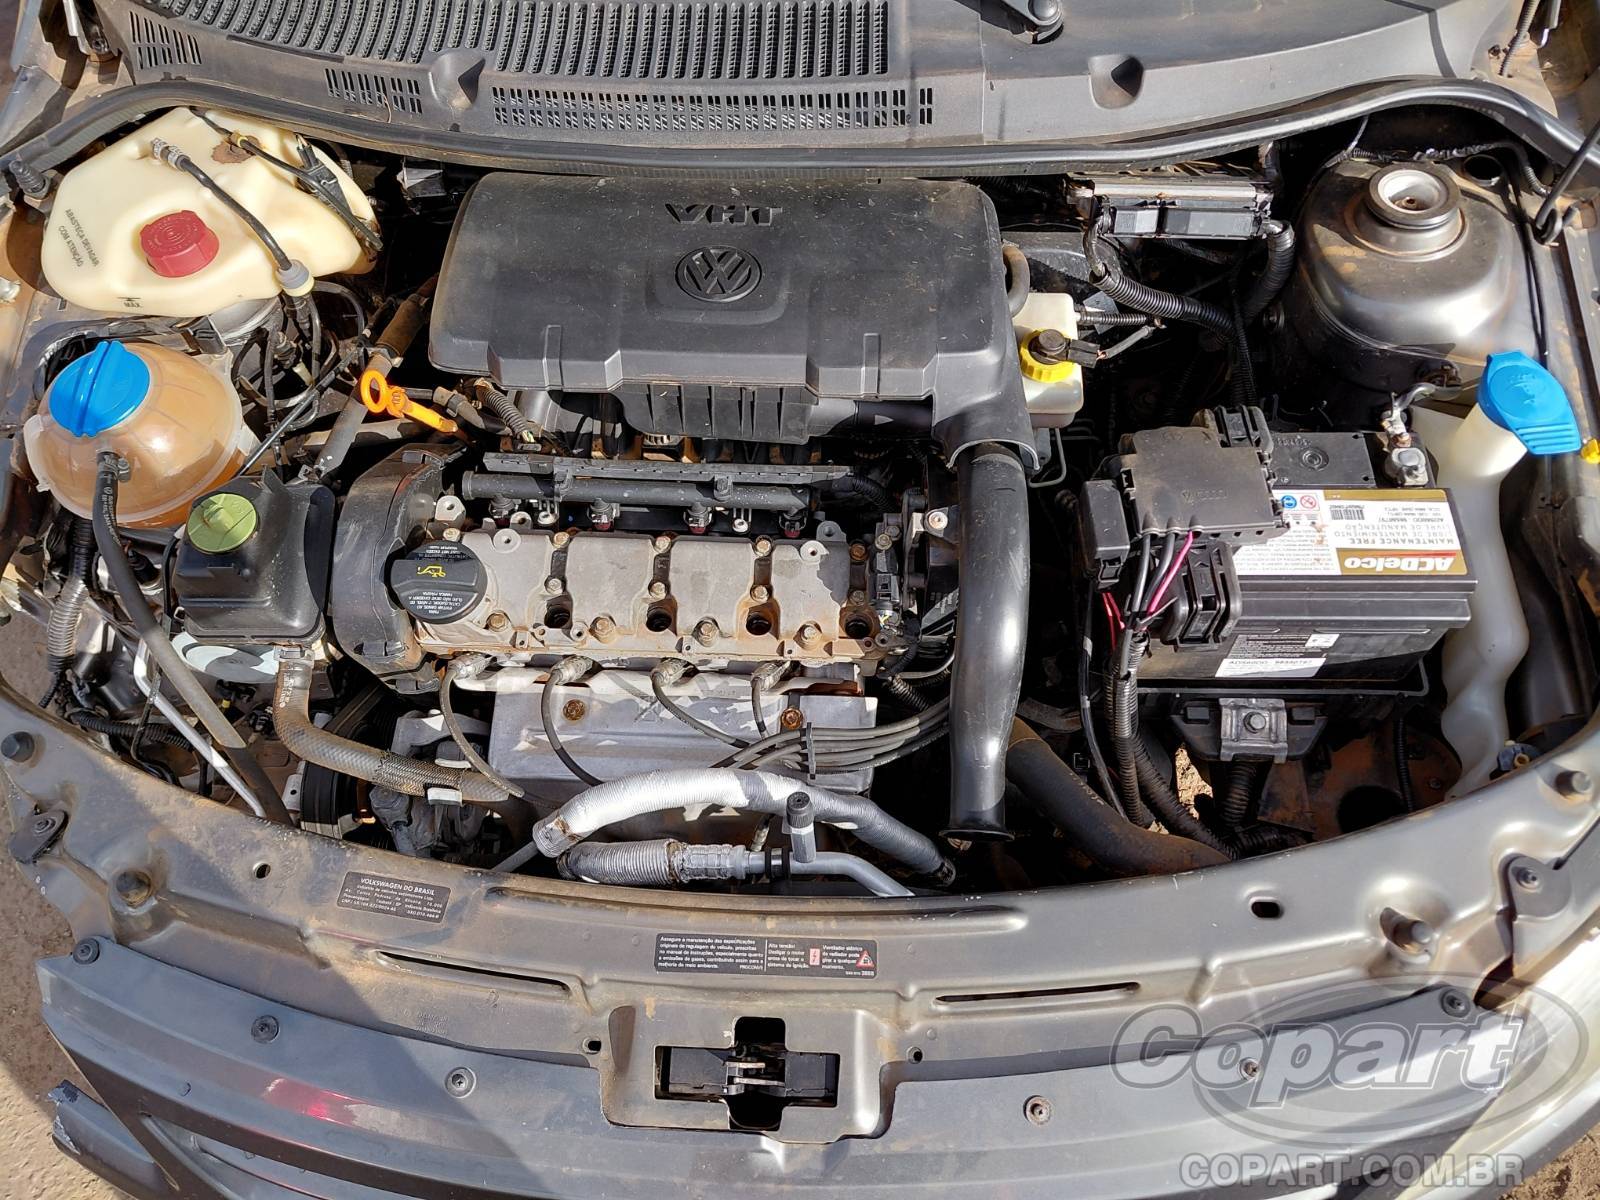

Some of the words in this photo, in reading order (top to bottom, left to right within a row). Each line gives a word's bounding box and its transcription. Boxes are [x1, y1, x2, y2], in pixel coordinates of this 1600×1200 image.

[665, 203, 782, 226] VHT
[1345, 557, 1454, 572] ACDelco
[361, 878, 402, 890] VOLKSWAGEN
[414, 887, 435, 895] BRASIL
